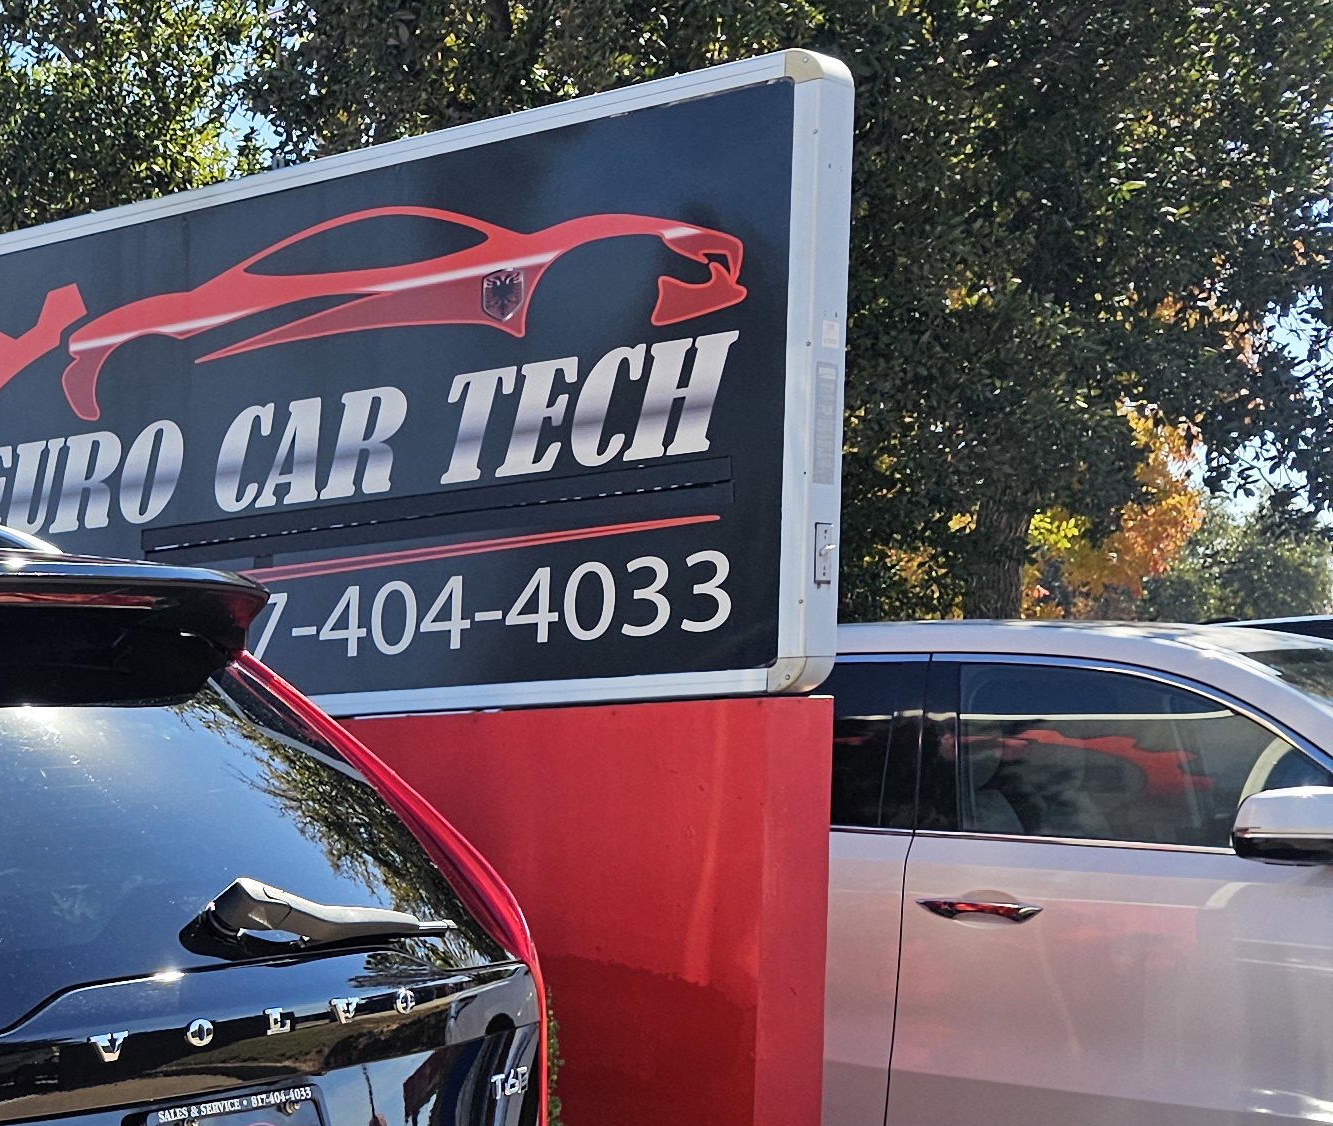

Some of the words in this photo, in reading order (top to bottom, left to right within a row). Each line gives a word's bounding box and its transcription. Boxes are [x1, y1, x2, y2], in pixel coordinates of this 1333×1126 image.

[214, 386, 408, 512] CAR
[440, 330, 739, 484] TECH
[88, 988, 416, 1063] VOLVO
[157, 1106, 189, 1123] SALES
[190, 1105, 200, 1118] &
[200, 1098, 242, 1116] SERVICE
[251, 1086, 312, 1108] 817-404-4033
